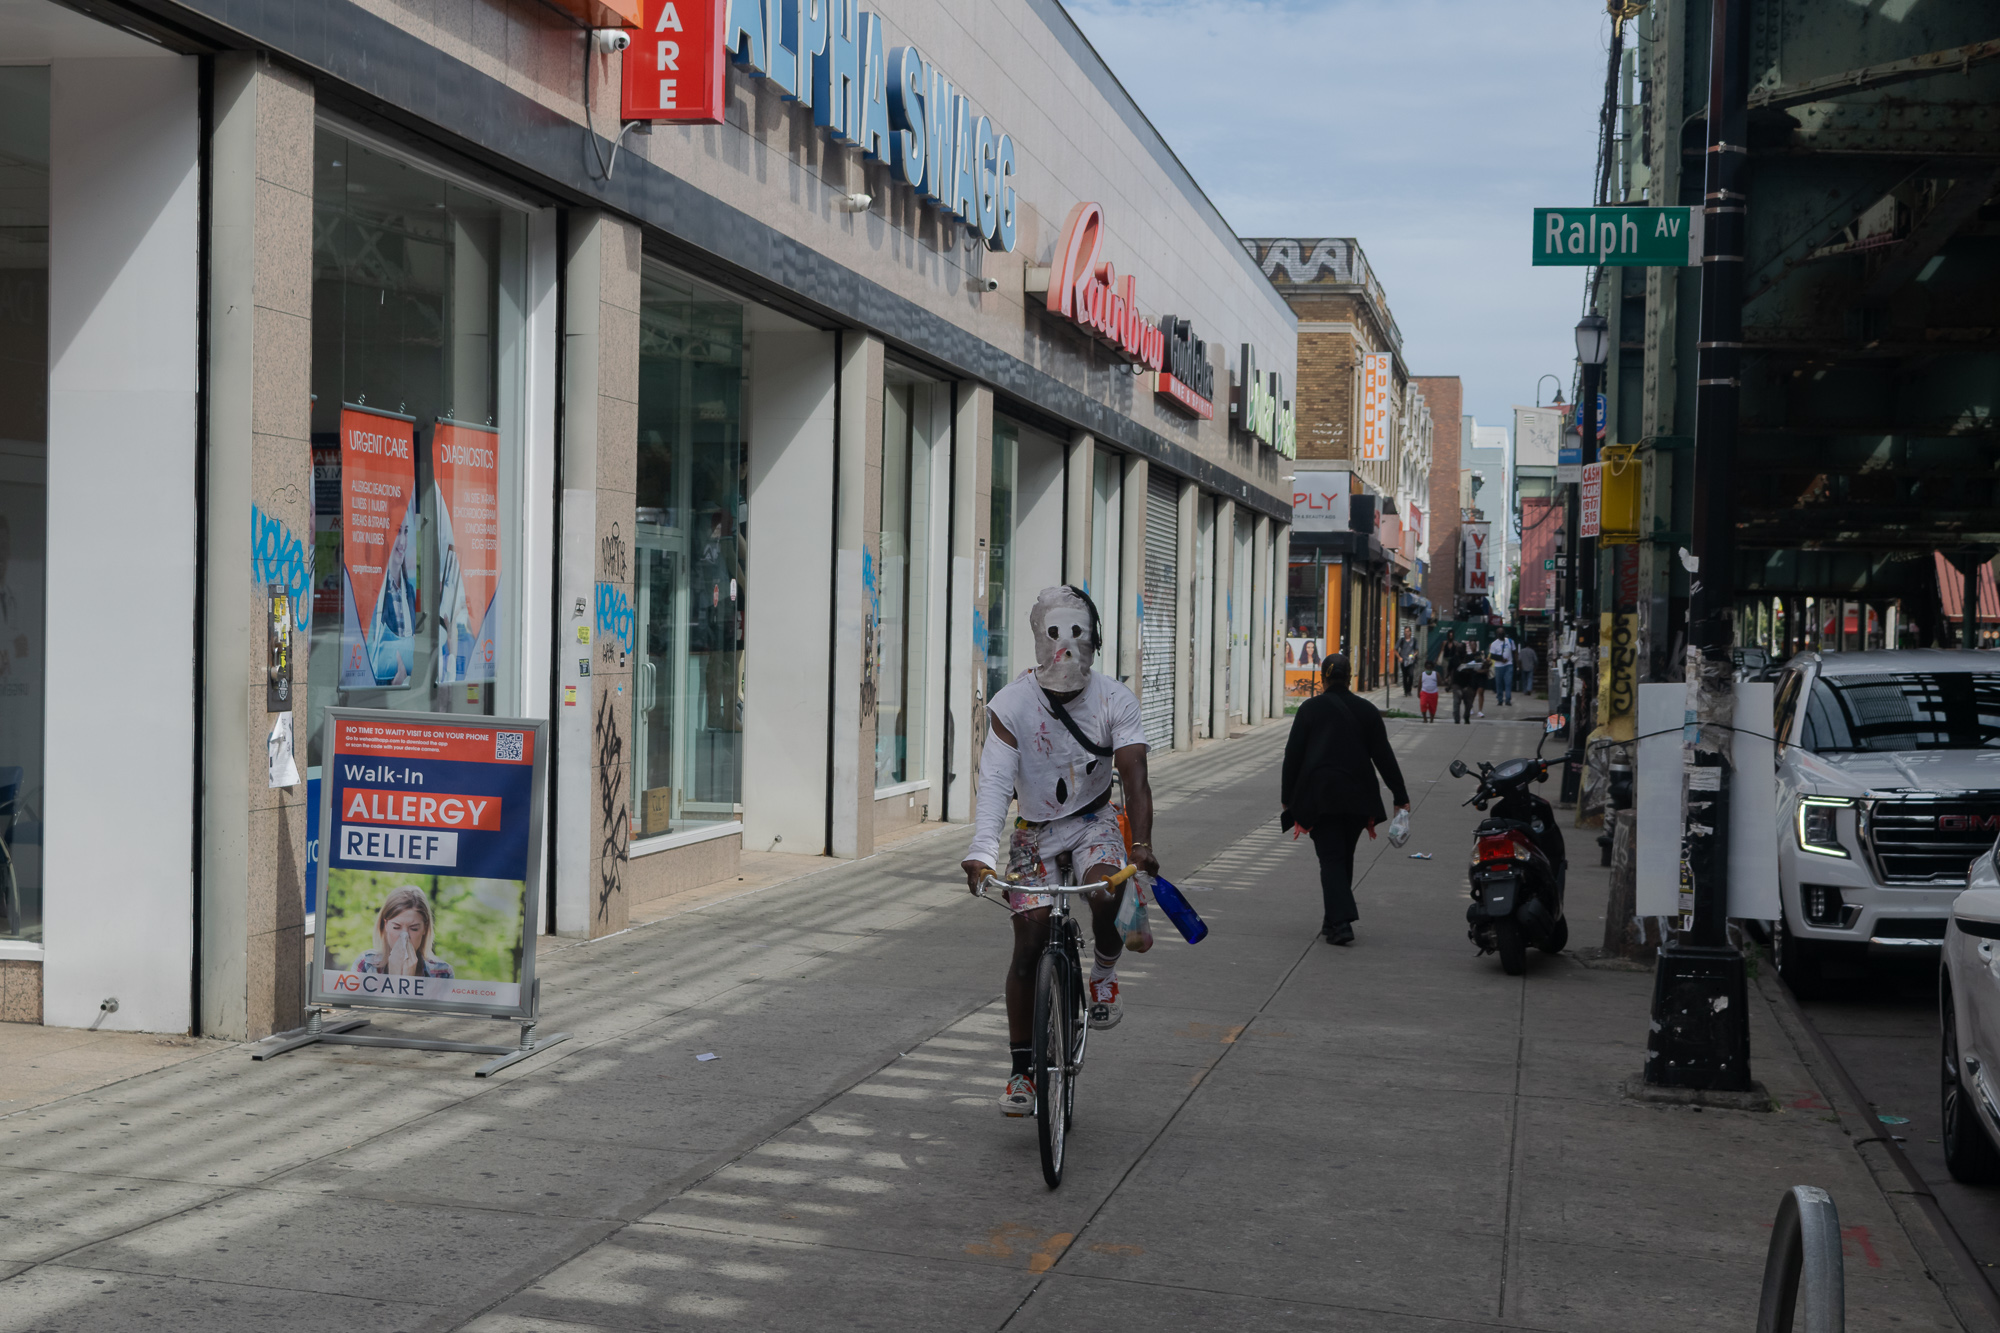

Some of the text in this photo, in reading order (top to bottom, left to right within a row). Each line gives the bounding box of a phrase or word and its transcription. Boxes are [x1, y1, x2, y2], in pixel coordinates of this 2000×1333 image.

[891, 46, 1017, 253] SWAGG
[1545, 212, 1681, 265] Ralph Av
[1047, 201, 1164, 372] Rainbow
[1170, 377, 1185, 400] WINE
[1191, 393, 1213, 418] SPIRITS
[1365, 356, 1376, 457] BEAUTY
[1376, 357, 1387, 457] SUPPLY
[349, 429, 409, 459] URGENT CARE
[441, 443, 494, 469] DIAGNOSTICS
[352, 479, 401, 498] ALLERGIC REACTIONS
[352, 496, 367, 510] ILLNESS
[371, 499, 388, 512] INJURY
[471, 492, 480, 505] SITE
[1582, 498, 1598, 511] (917)
[352, 513, 367, 527] BREAKS
[371, 516, 390, 530] STRAINS
[1584, 511, 1597, 524] 515
[352, 530, 384, 546] WORK INJURIES
[465, 522, 496, 535] SONOGRAMS
[1581, 523, 1599, 536] 6499
[471, 538, 484, 550] ECG
[1469, 533, 1487, 589] VIM
[385, 728, 405, 736] WAIT?
[465, 733, 489, 741] PHONE
[406, 738, 430, 746] download
[344, 764, 424, 784] Walk-In
[347, 793, 487, 826] ALLERGY
[347, 831, 439, 860] RELIEF
[451, 988, 497, 997] AGCARE.COM
